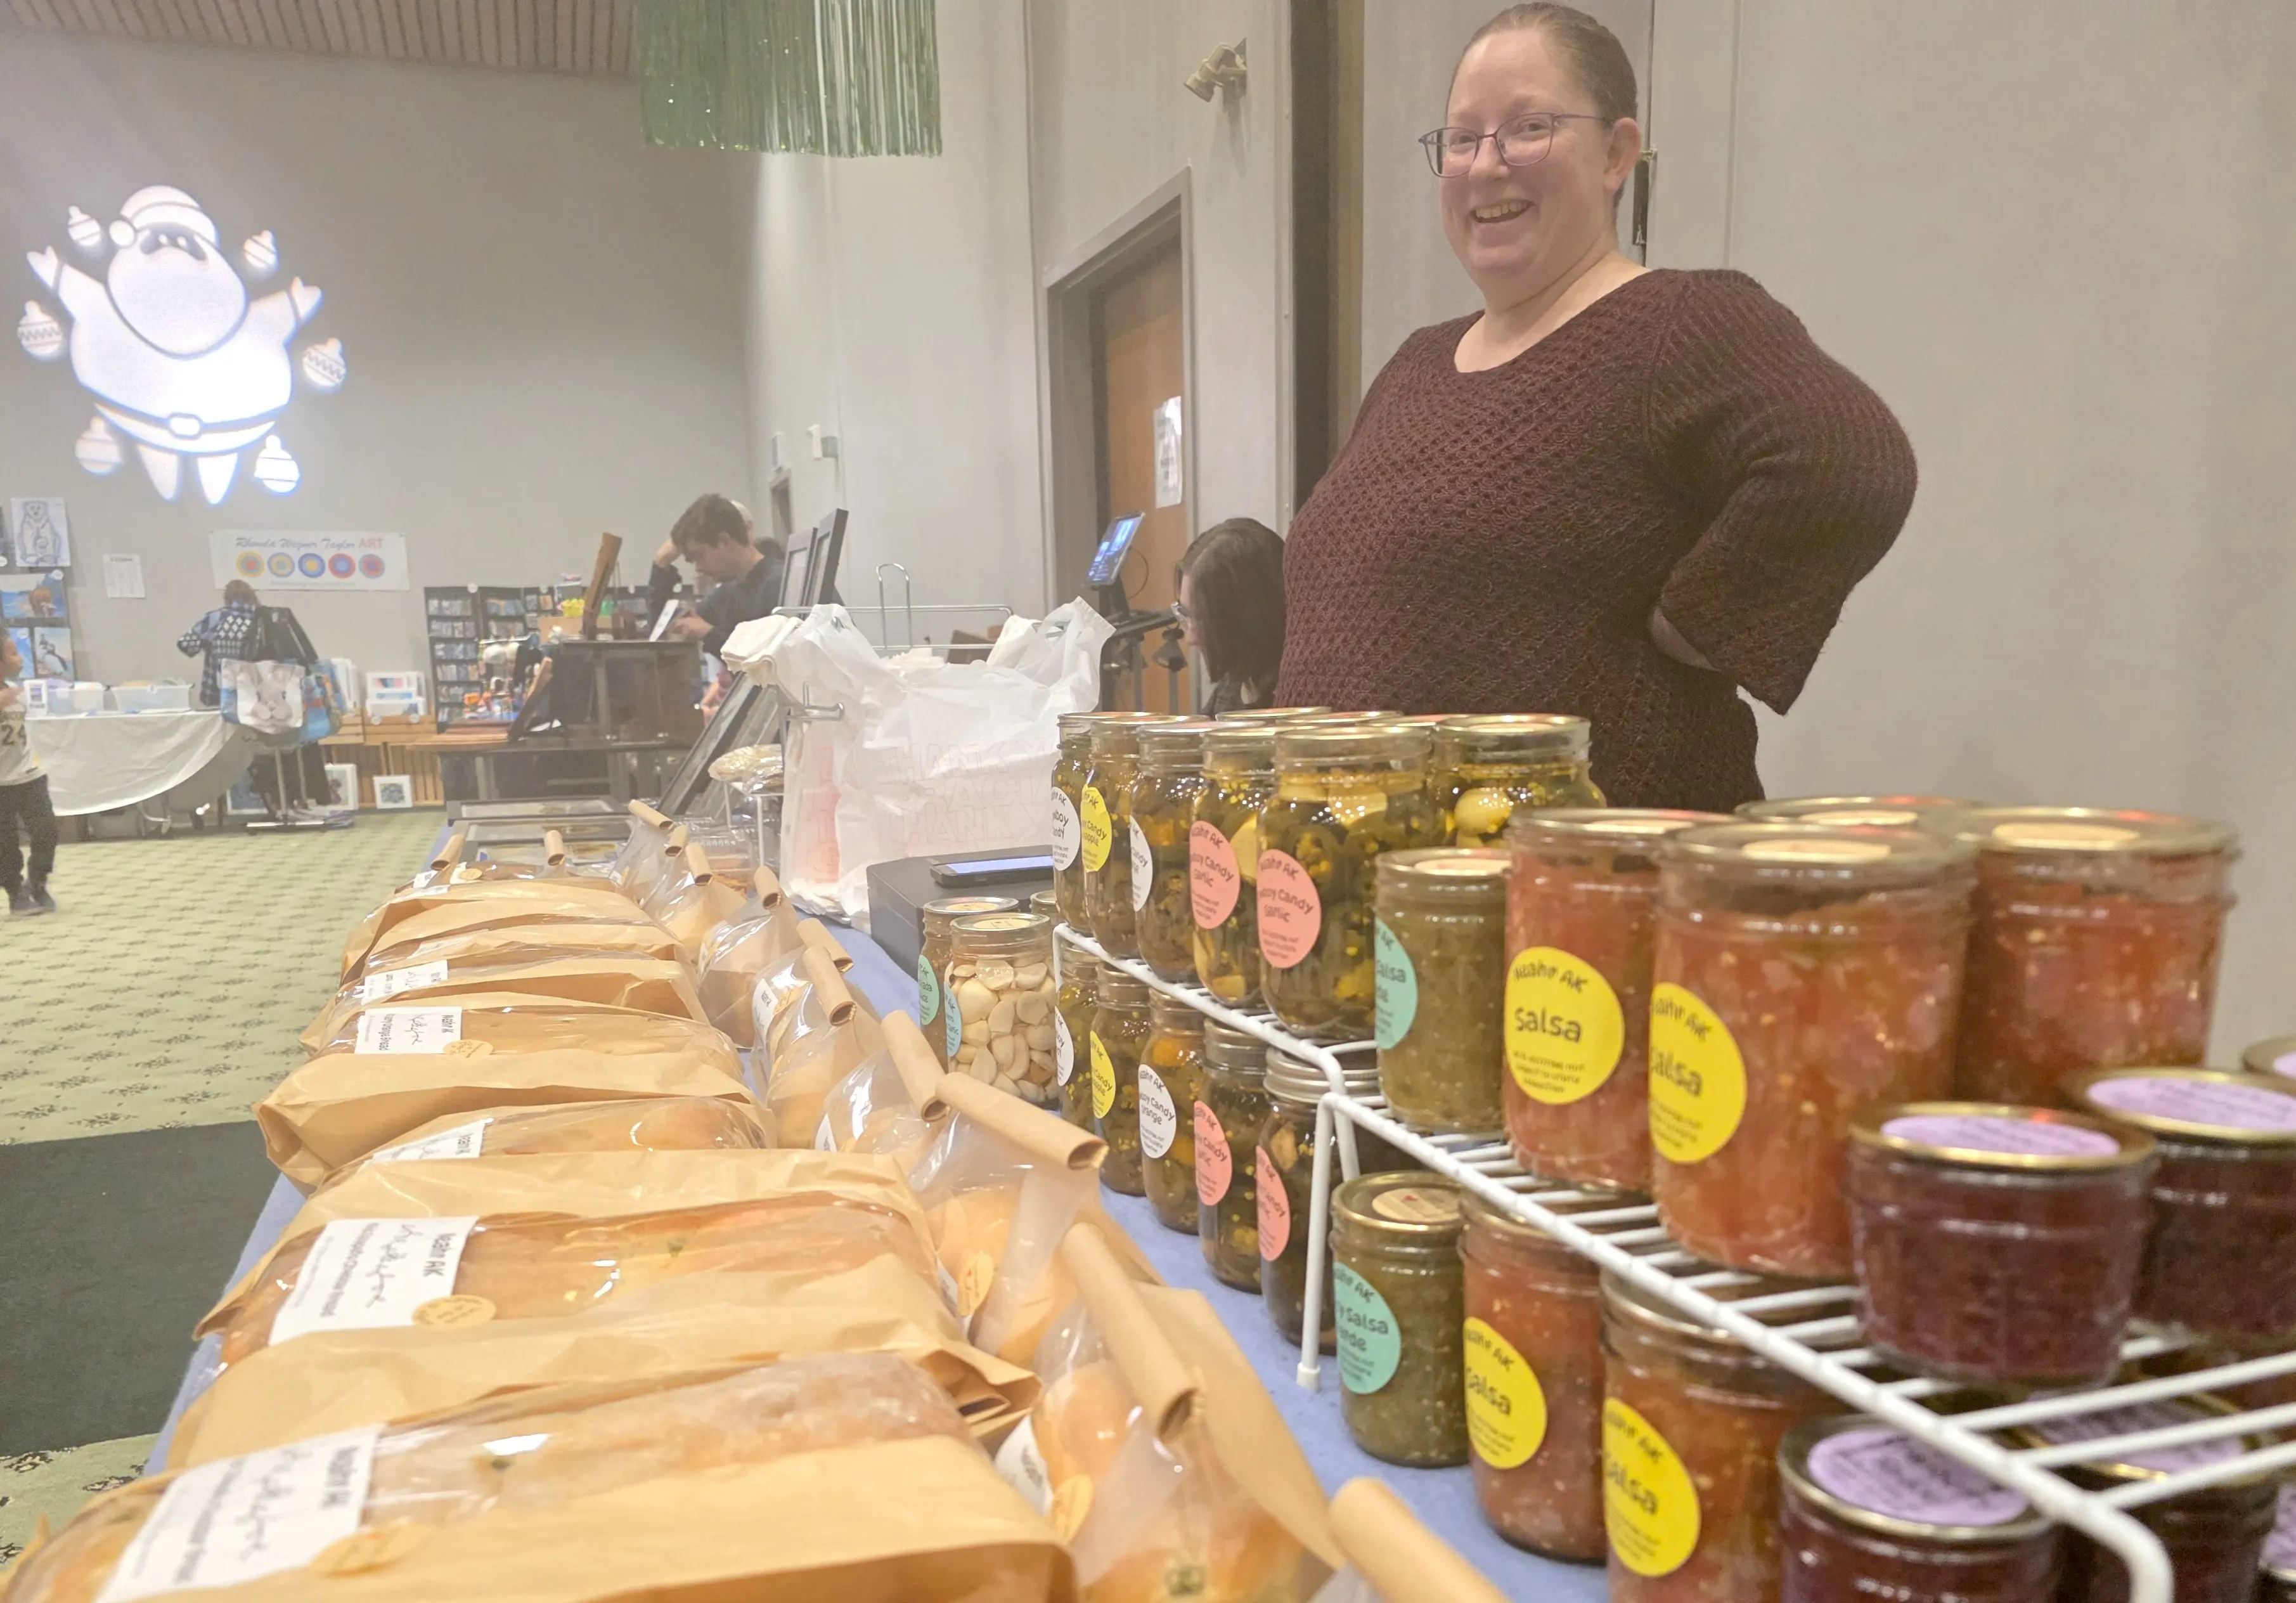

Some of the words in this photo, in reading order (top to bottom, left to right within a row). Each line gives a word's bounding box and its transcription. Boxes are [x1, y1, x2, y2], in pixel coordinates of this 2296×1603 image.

[359, 538, 384, 549] ART
[1204, 855, 1234, 883] Candy
[1277, 888, 1314, 915] Candy
[1559, 970, 1589, 995] AK
[1514, 1007, 1582, 1044] Salsa
[1151, 1097, 1175, 1122] Candy
[423, 1260, 446, 1276] AK
[1354, 1281, 1374, 1303] AK
[1346, 1307, 1389, 1335] Salsa
